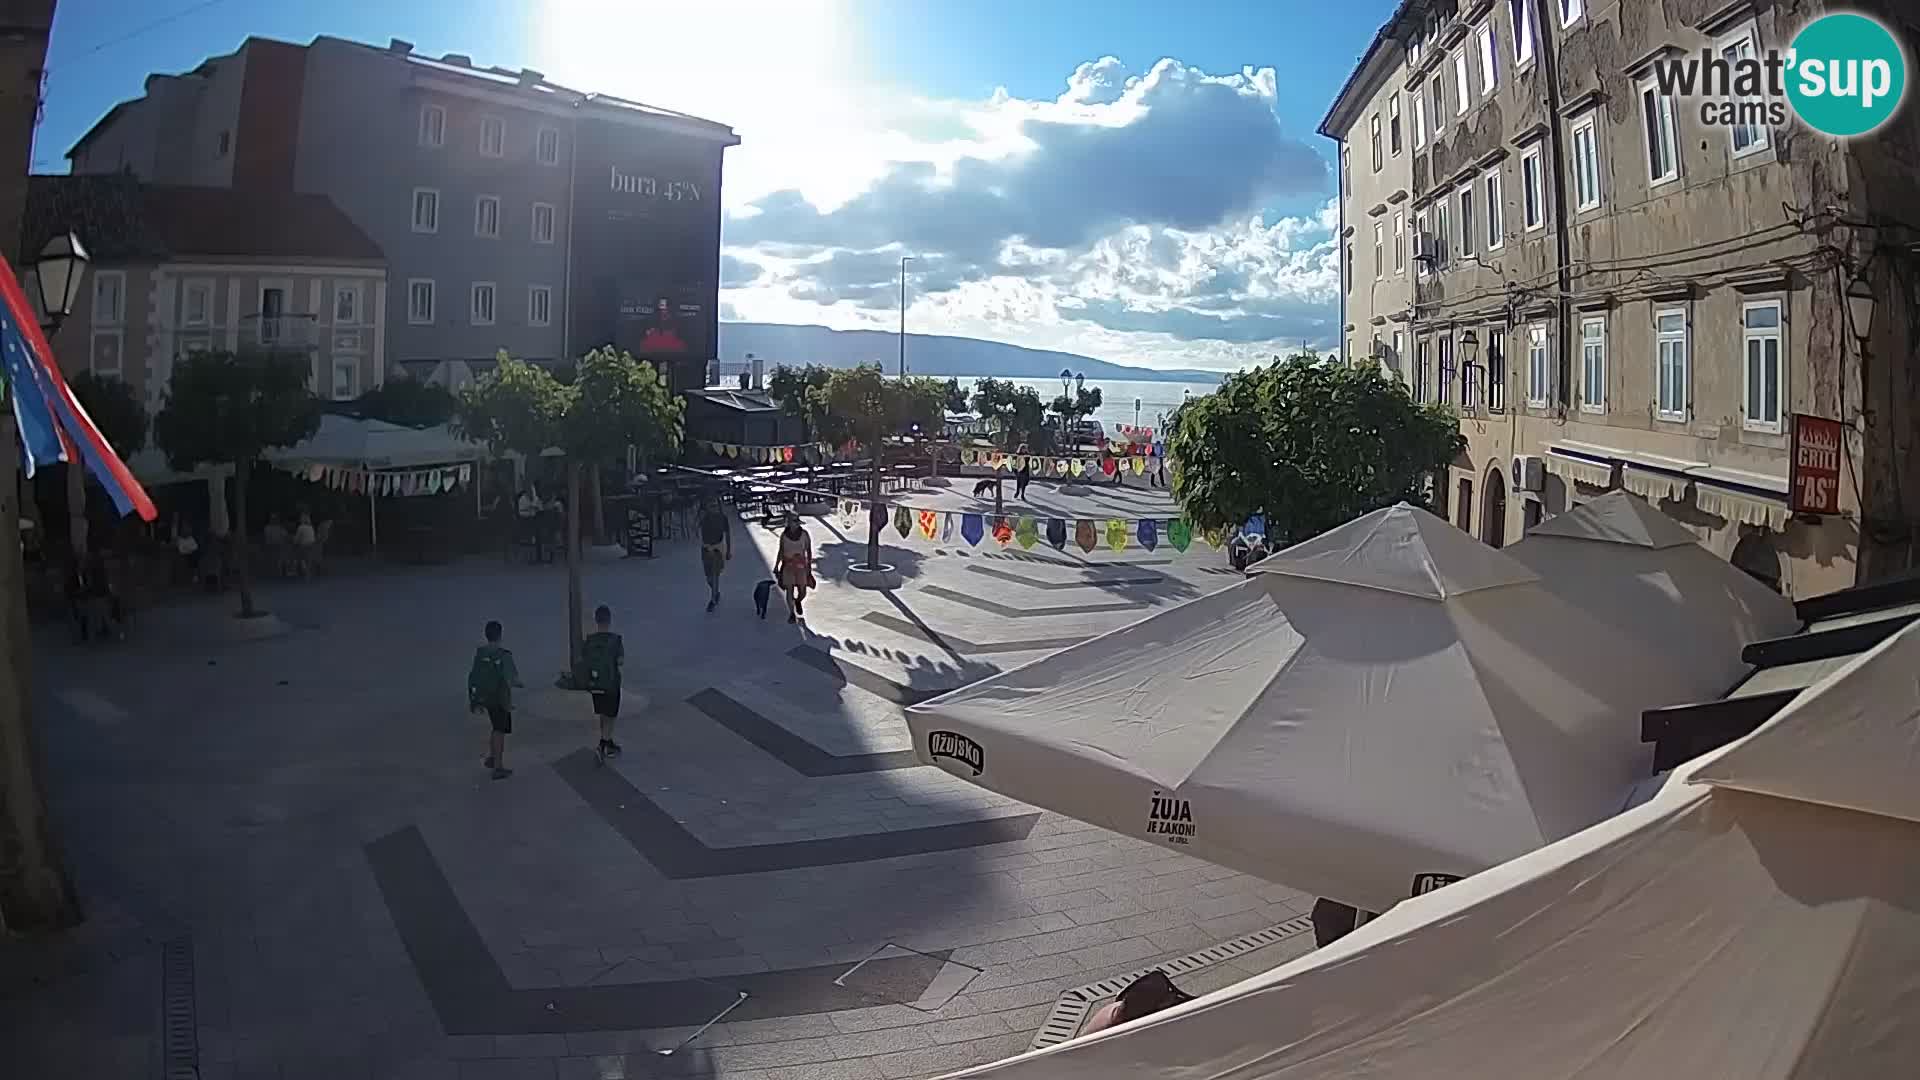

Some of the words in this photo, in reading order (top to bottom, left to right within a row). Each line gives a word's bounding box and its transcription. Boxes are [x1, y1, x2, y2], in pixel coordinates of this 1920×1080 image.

[610, 165, 656, 195] bura
[1798, 447, 1838, 472] GRILL
[1149, 790, 1192, 822] ŽUJA
[1146, 820, 1157, 833] JE
[1158, 821, 1196, 837] ZAKON!
